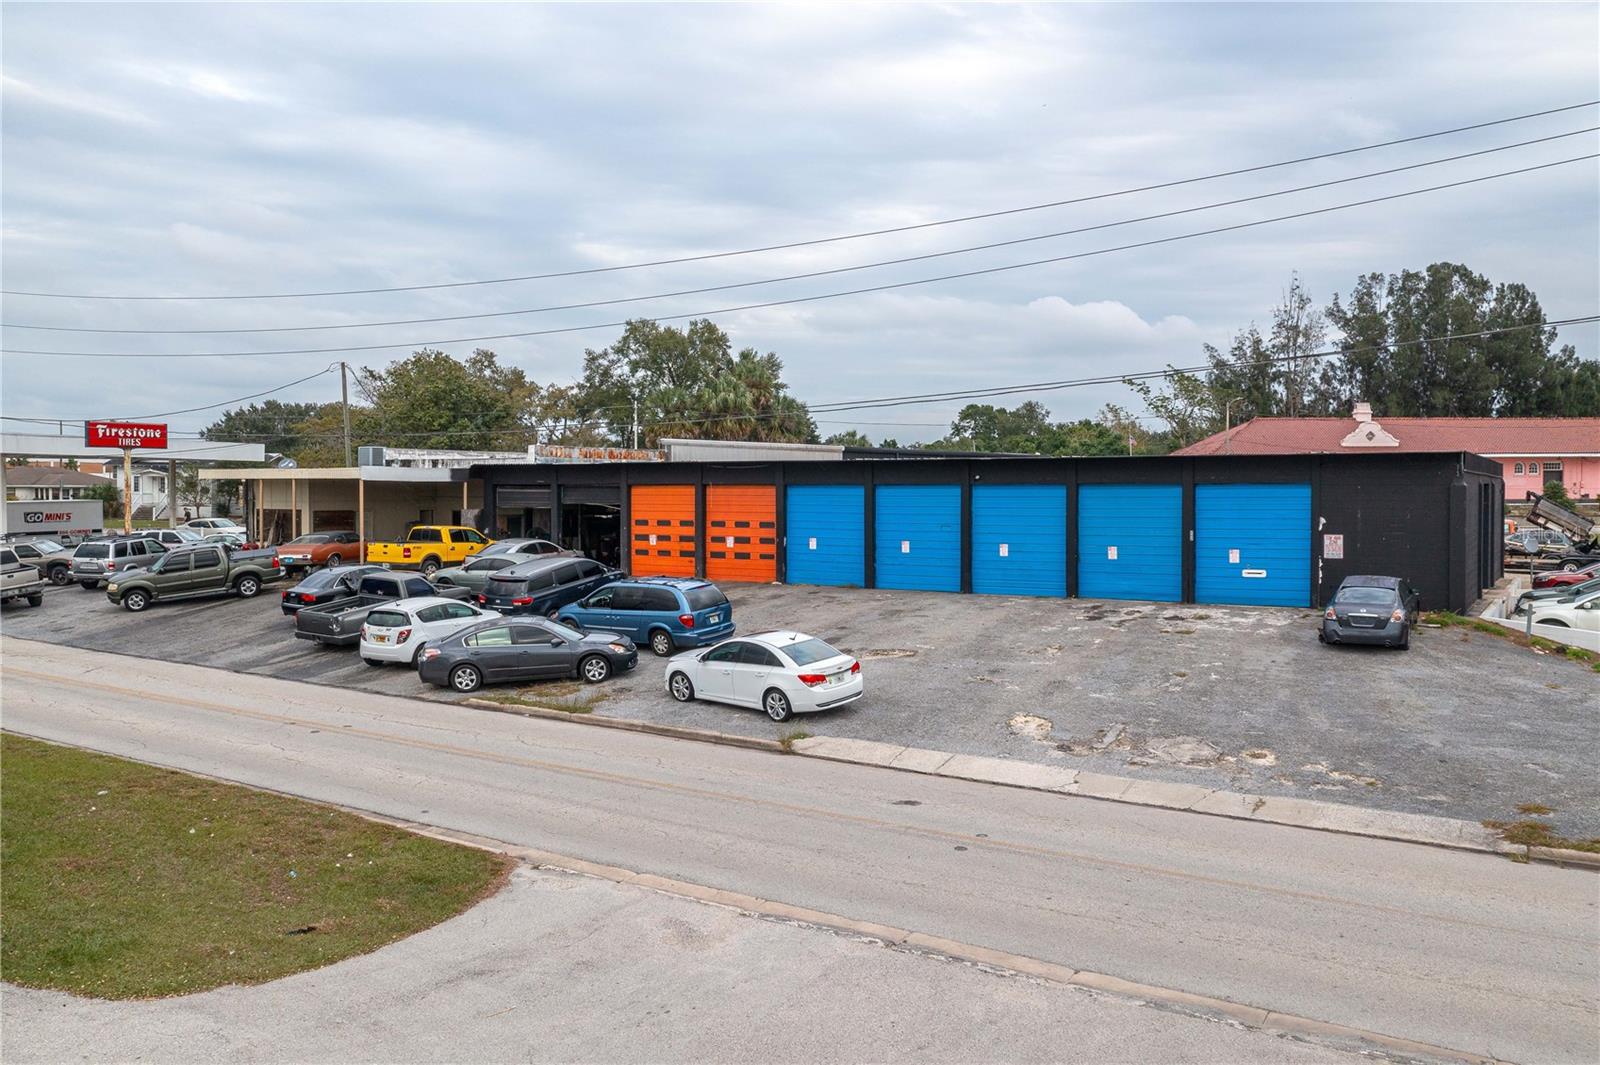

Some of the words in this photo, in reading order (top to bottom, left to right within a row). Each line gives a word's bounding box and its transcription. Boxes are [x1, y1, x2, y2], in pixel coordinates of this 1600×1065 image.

[96, 424, 161, 438] Firestone
[118, 438, 141, 446] TIRES
[26, 513, 42, 522] GO
